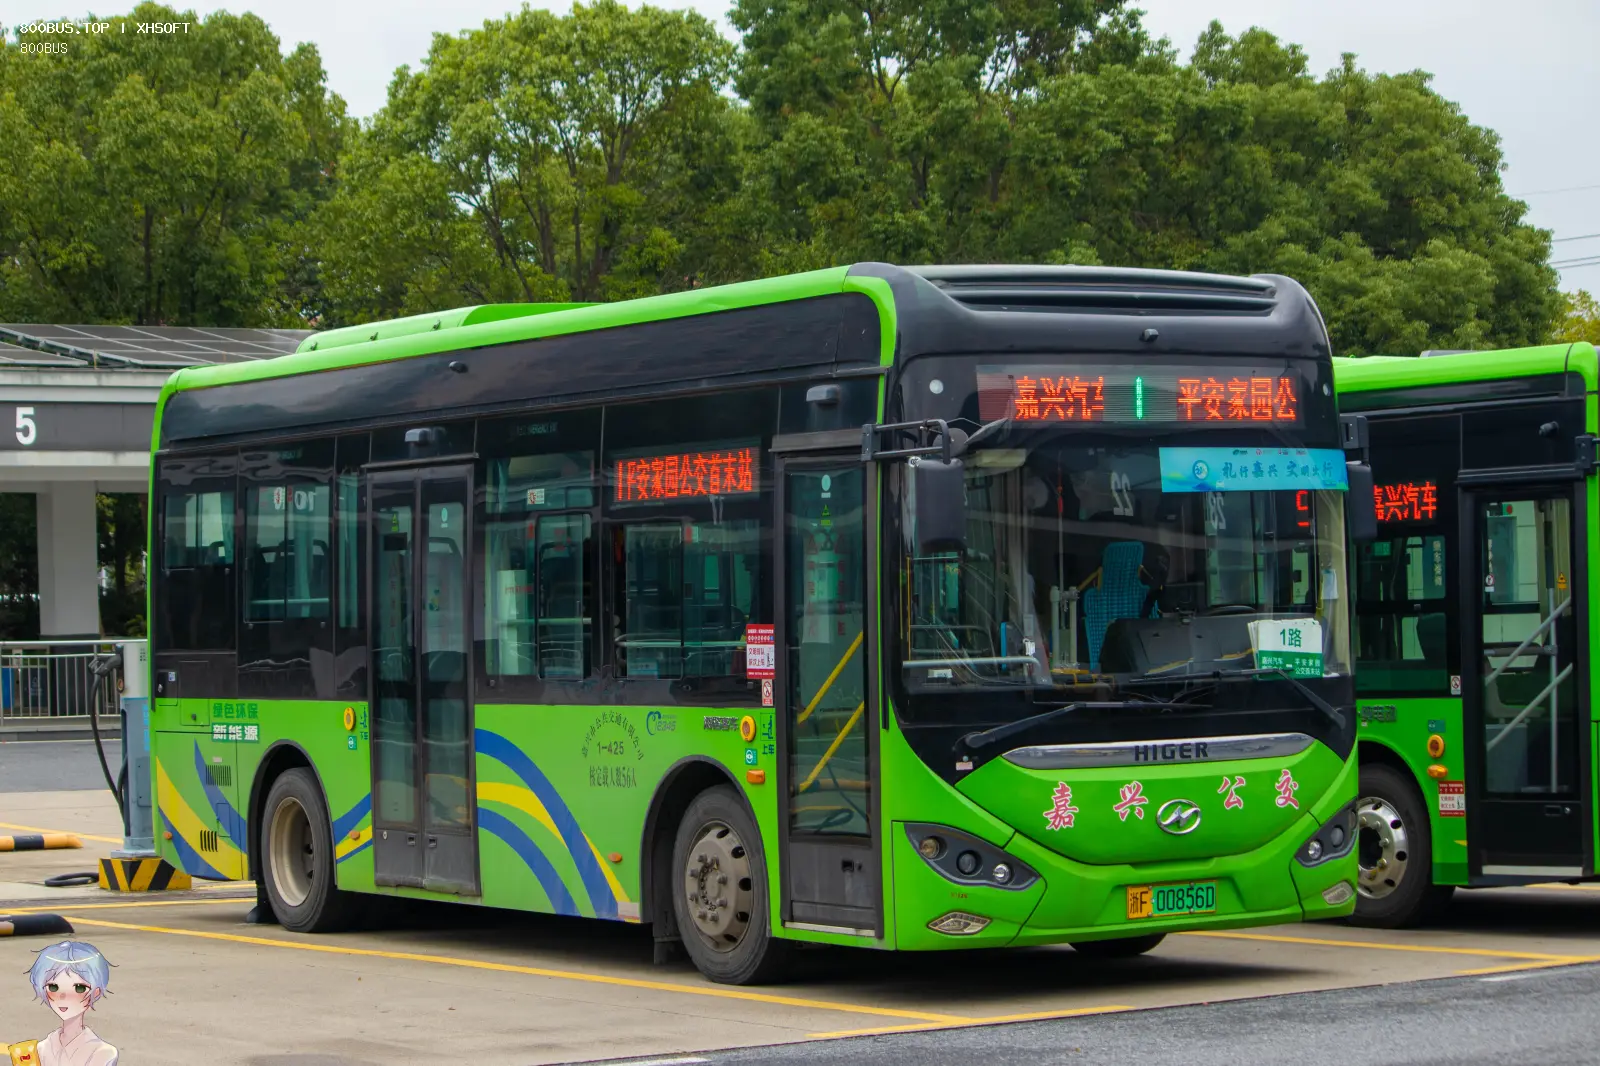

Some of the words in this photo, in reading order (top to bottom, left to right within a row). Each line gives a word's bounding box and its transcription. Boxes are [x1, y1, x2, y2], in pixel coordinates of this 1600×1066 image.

[1177, 377, 1297, 420] 平安家园公
[15, 406, 37, 445] 5
[1279, 627, 1302, 648] 1路
[212, 702, 259, 719] 绿色环保
[212, 724, 259, 741] 新能源
[597, 740, 625, 756] 1-425
[1133, 741, 1209, 762] HIGER
